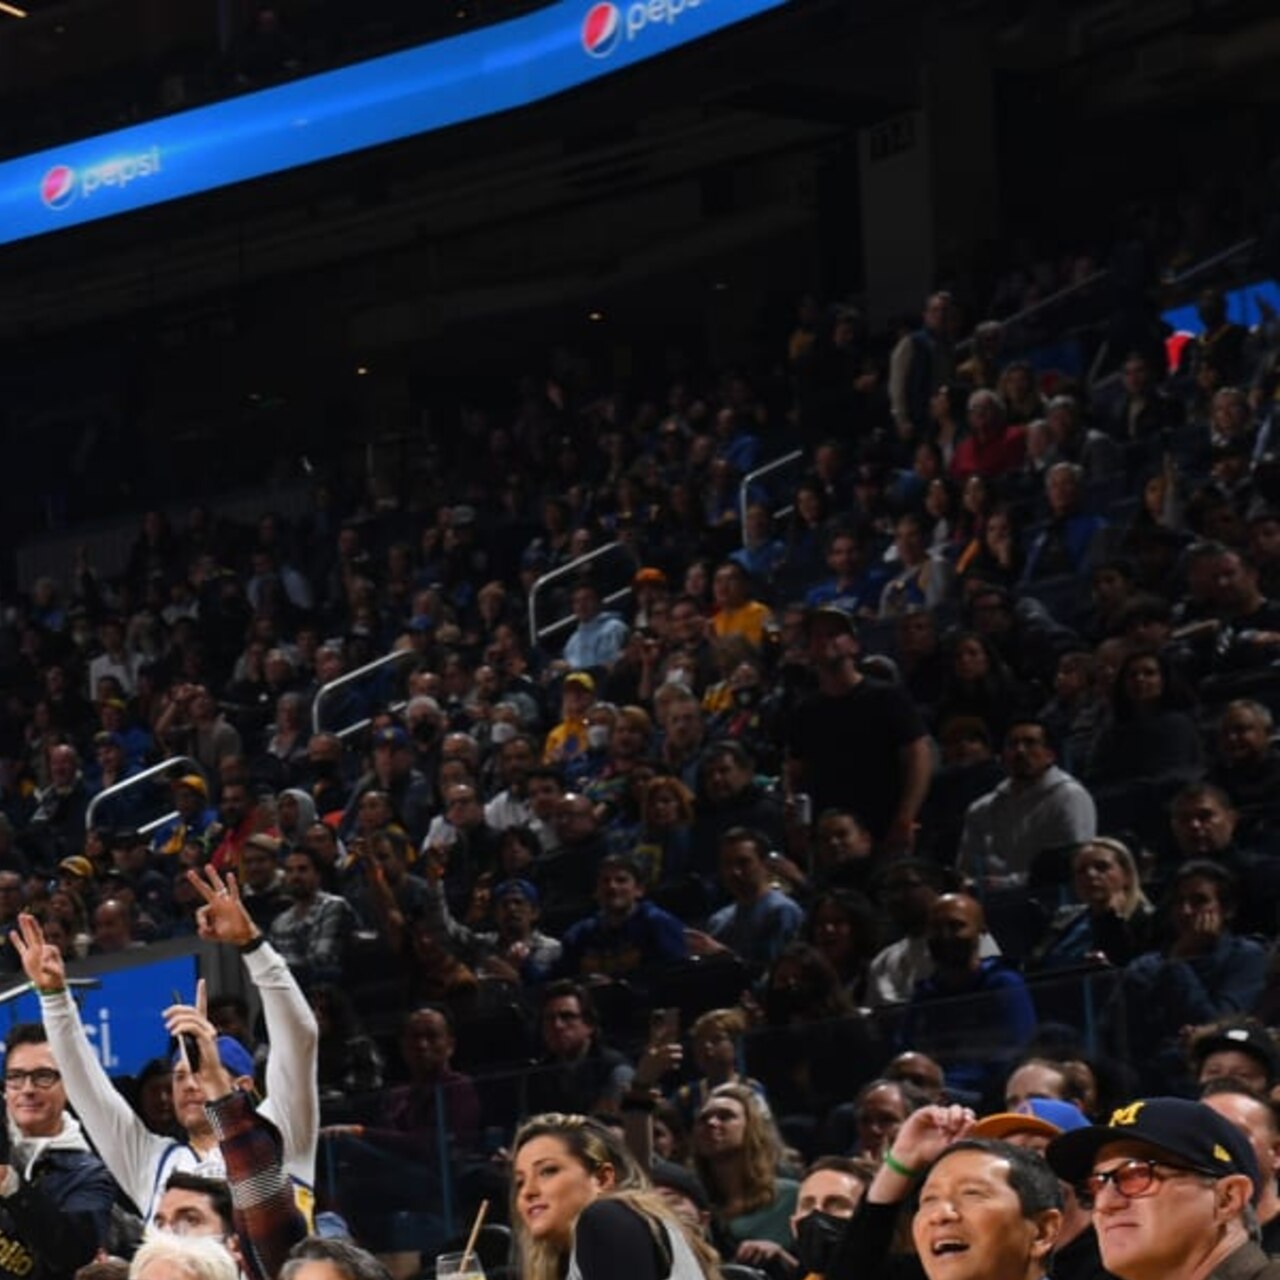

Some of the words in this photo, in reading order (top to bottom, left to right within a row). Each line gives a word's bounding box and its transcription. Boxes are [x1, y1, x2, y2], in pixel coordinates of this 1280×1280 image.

[626, 0, 701, 42] pep
[81, 145, 161, 196] pepsi
[1108, 1098, 1145, 1128] M
